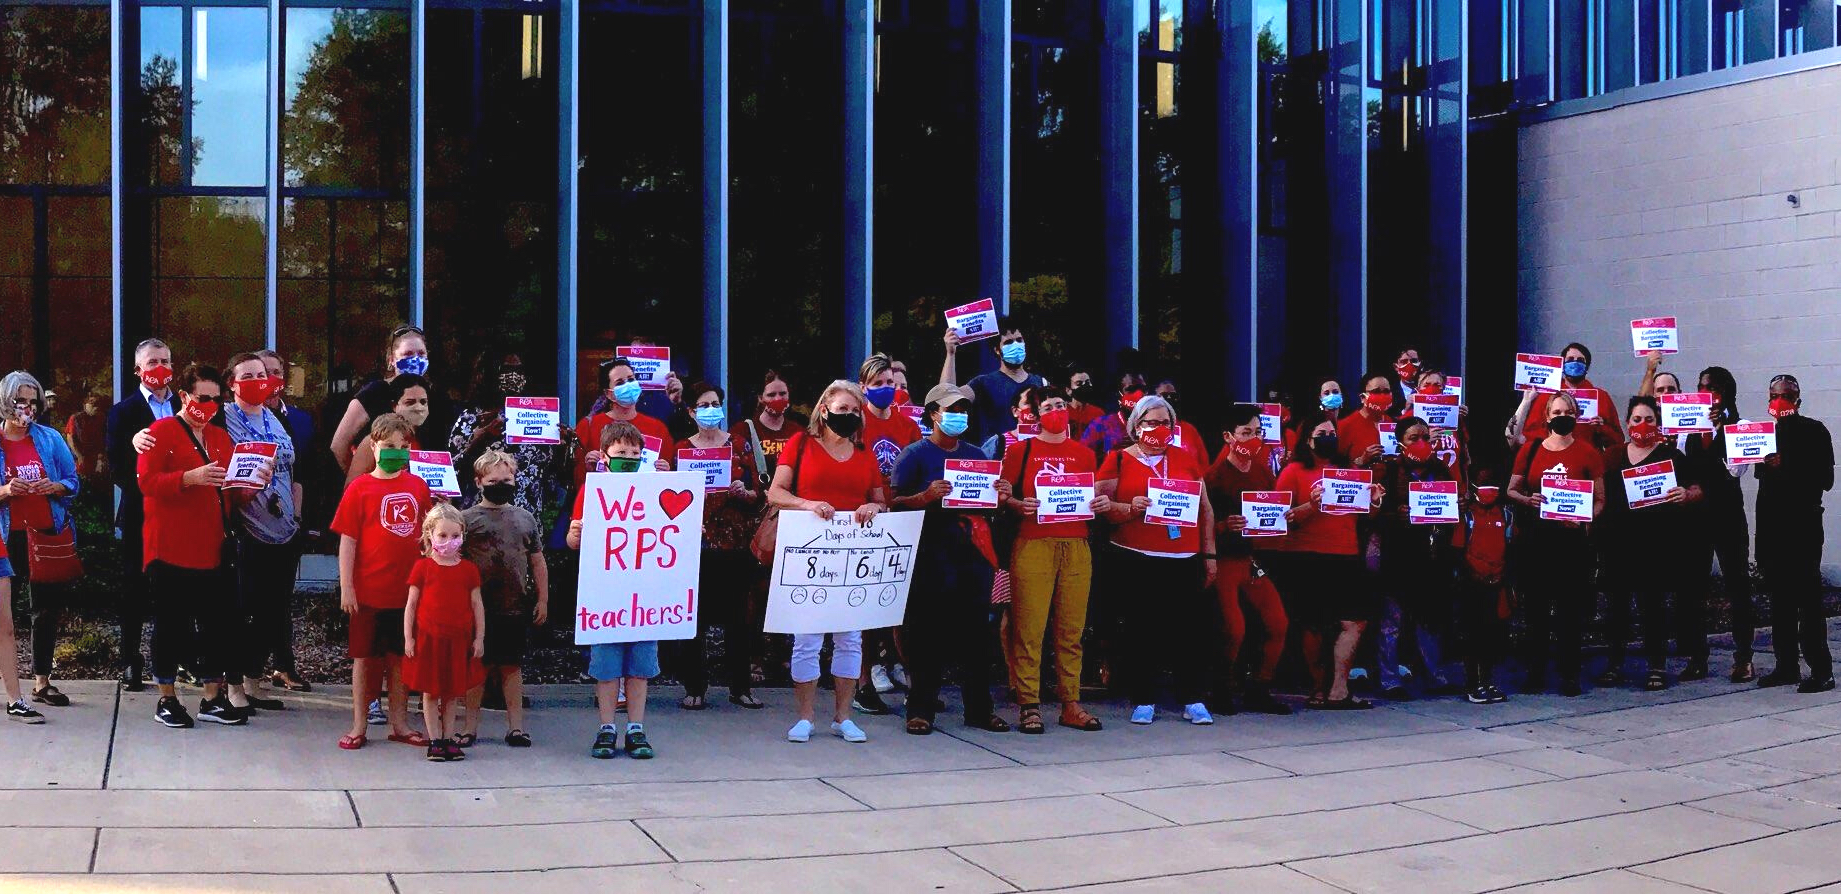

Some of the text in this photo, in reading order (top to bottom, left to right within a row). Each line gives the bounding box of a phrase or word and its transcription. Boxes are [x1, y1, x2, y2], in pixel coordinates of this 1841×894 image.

[956, 313, 987, 323] Bargaining
[961, 319, 984, 328] Benefits
[1524, 365, 1554, 373] Bargaining
[954, 481, 990, 489] Bargaining
[1633, 475, 1667, 486] Bargaining
[1639, 481, 1664, 491] Benefits
[1049, 488, 1082, 496] Collective
[597, 486, 646, 521] We
[1048, 495, 1085, 503] Bargaining
[1158, 500, 1190, 508] Bargaining
[1550, 497, 1584, 505] Bargaining
[831, 514, 852, 526] First
[825, 528, 884, 543] Days of School
[605, 525, 680, 571] RPS
[807, 556, 839, 583] 8 days
[855, 556, 870, 579] 6
[888, 552, 902, 579] 4
[578, 589, 694, 632] teachers!
